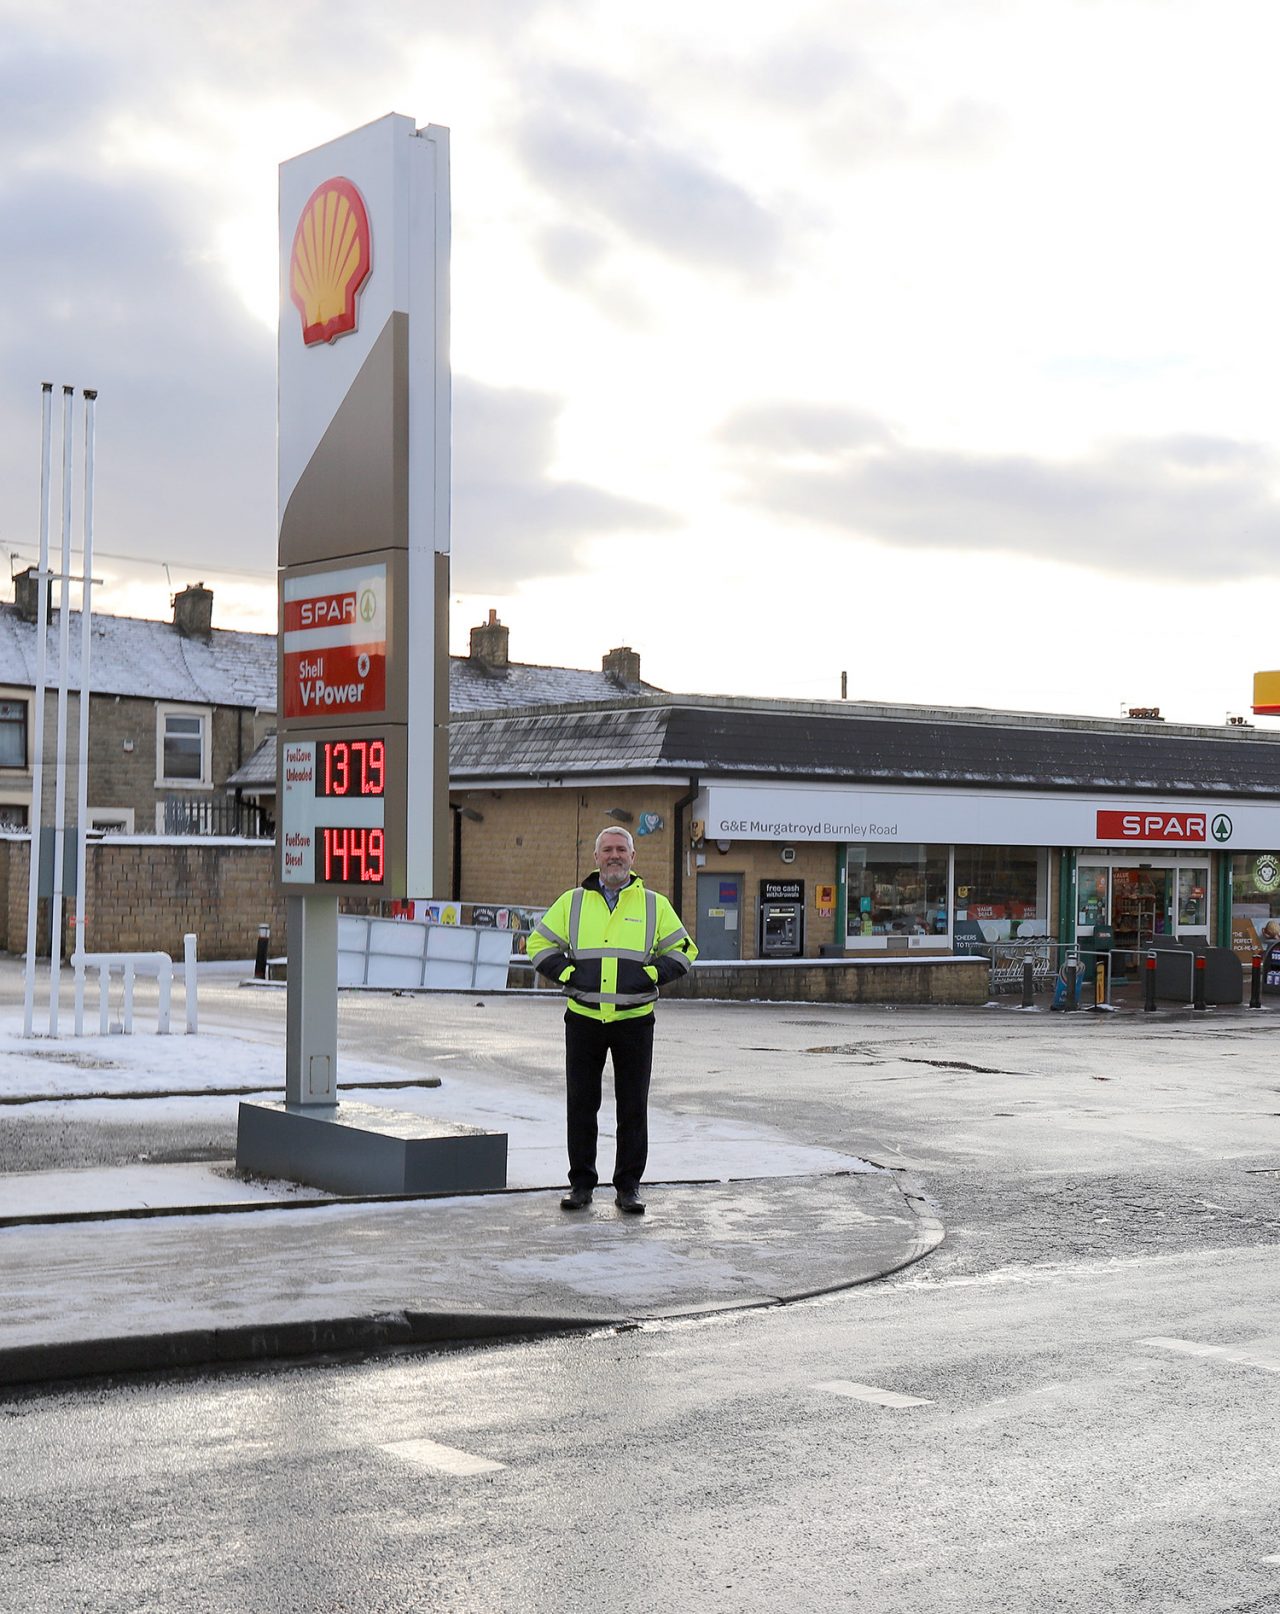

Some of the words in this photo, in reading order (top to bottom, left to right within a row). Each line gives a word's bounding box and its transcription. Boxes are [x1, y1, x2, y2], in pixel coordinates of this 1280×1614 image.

[301, 598, 355, 625] SPAR
[300, 658, 323, 679] Shell
[300, 680, 364, 706] V-Power
[286, 747, 311, 763] FuelSave
[286, 767, 312, 782] Unleaded
[720, 820, 747, 832] G&E
[751, 821, 821, 836] Murgatroyd
[823, 823, 867, 837] Burnley
[869, 824, 898, 836] Road
[1122, 815, 1206, 837] SPAR
[285, 832, 310, 847] FuelSave
[285, 852, 303, 866] Diesel
[766, 883, 781, 893] free
[782, 883, 799, 893] cash
